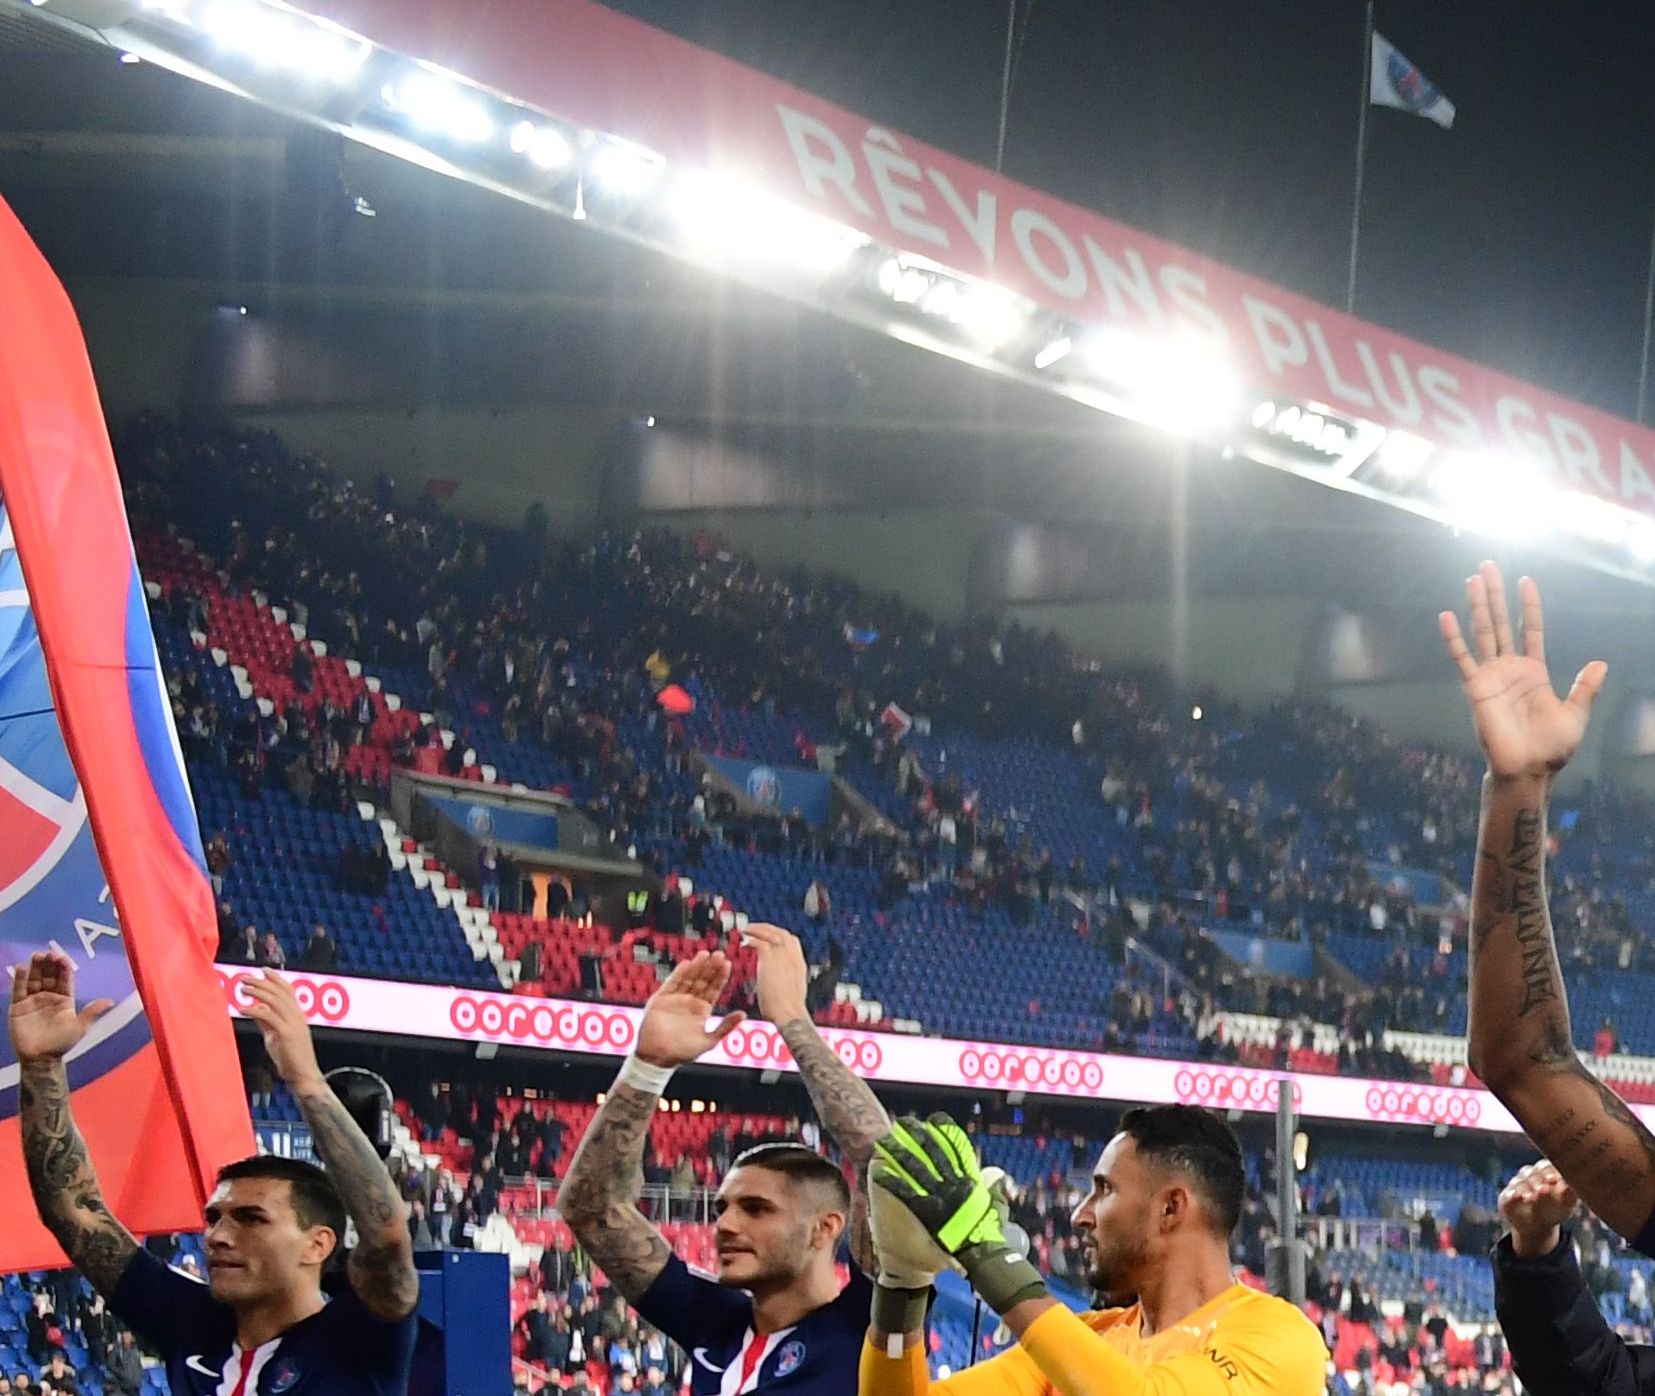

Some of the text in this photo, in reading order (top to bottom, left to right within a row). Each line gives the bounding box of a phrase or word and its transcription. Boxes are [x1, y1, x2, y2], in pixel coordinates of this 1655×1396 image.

[777, 104, 1230, 345] RÊVONS
[1243, 294, 1483, 449] PLUS
[450, 995, 634, 1049] ooredoo
[722, 1026, 882, 1070] ooroo
[959, 1048, 1104, 1090] ooredoo
[1174, 1070, 1302, 1112] ooredo
[1365, 1087, 1482, 1123] ooredoo
